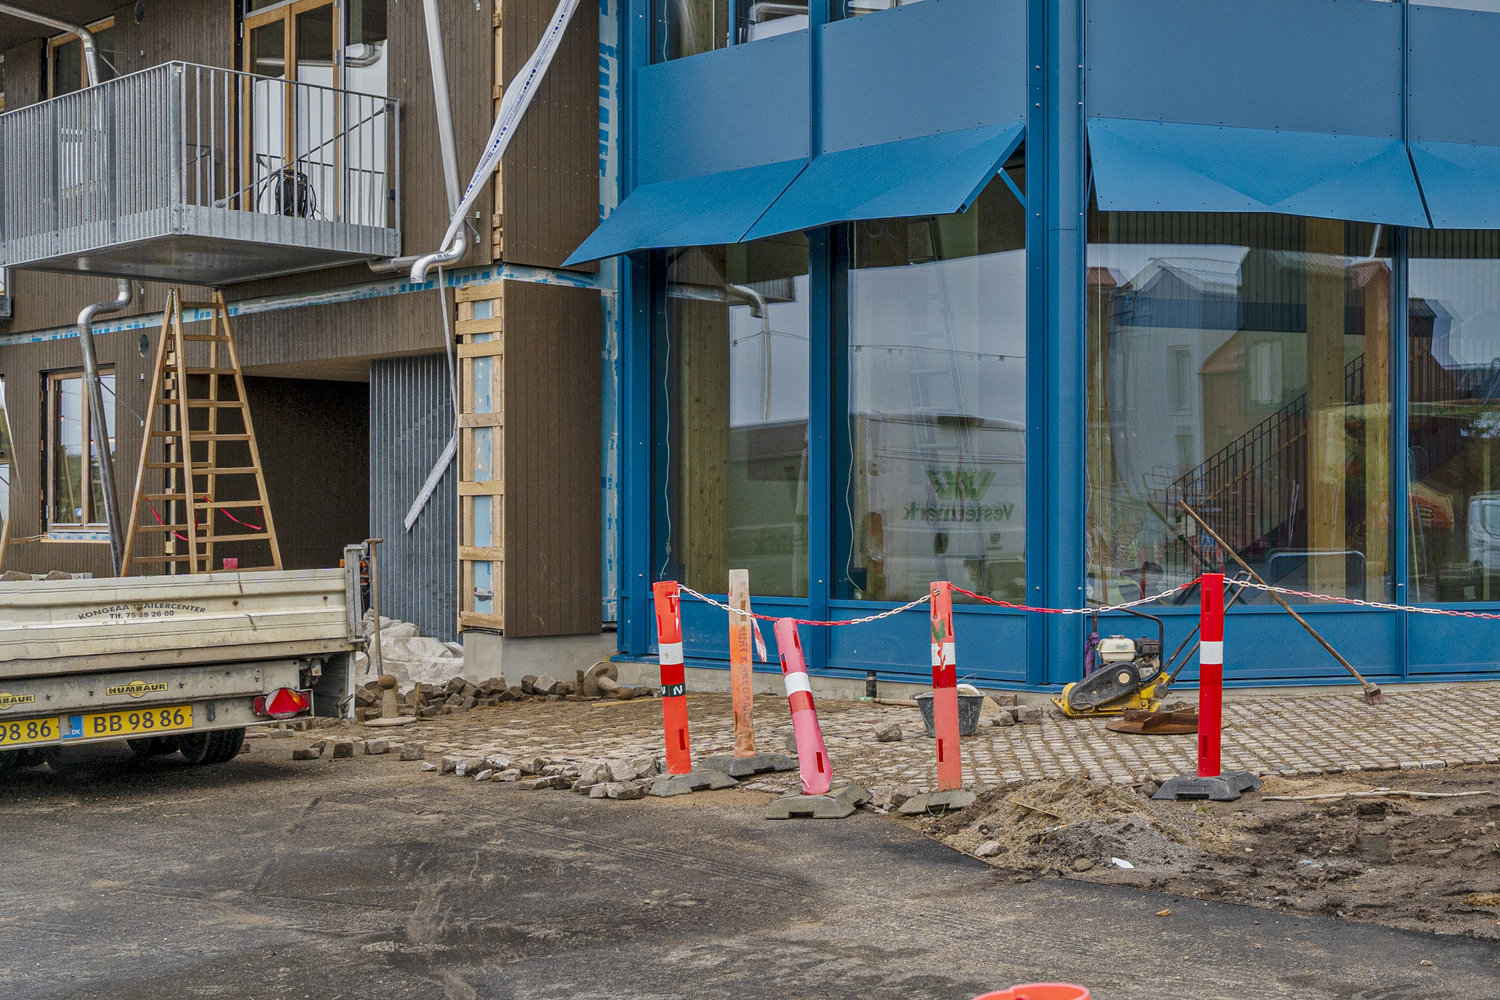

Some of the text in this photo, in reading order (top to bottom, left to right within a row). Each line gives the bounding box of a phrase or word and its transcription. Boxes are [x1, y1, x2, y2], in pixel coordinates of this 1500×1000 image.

[108, 683, 167, 695] HUMBAUR
[0, 696, 33, 704] BAUR
[94, 709, 185, 733] BB 98 86
[0, 720, 52, 742] 98 86
